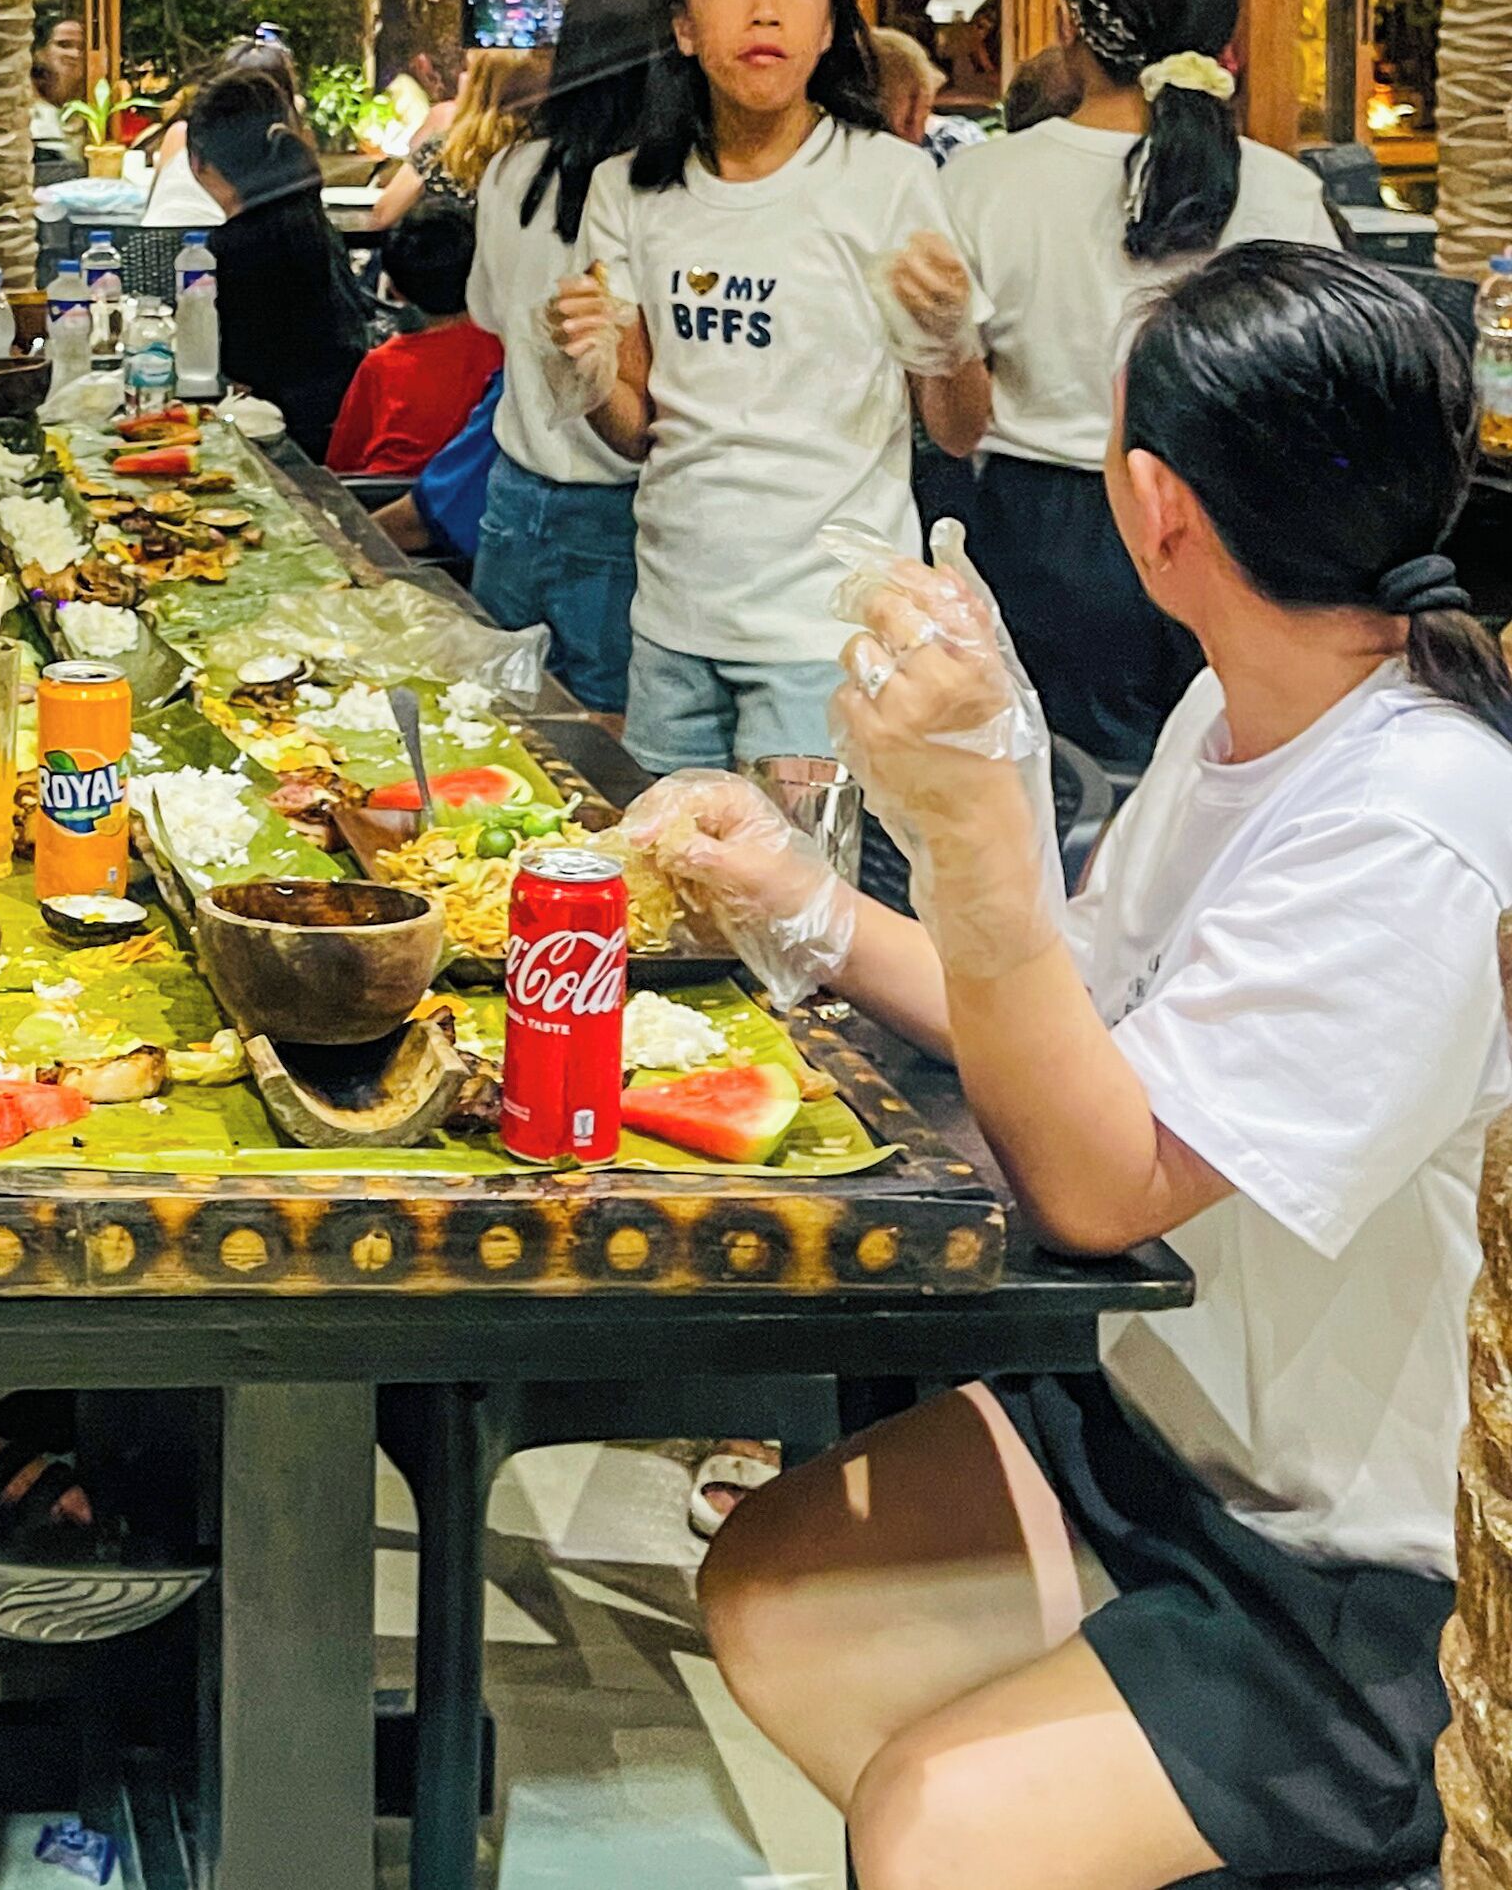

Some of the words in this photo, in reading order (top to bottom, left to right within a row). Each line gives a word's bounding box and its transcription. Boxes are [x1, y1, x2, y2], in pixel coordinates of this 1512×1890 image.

[671, 270, 680, 295] I
[724, 275, 777, 303] MY
[672, 303, 771, 348] BFFS
[39, 764, 125, 809] ROYAL
[527, 1018, 571, 1036] TASTE
